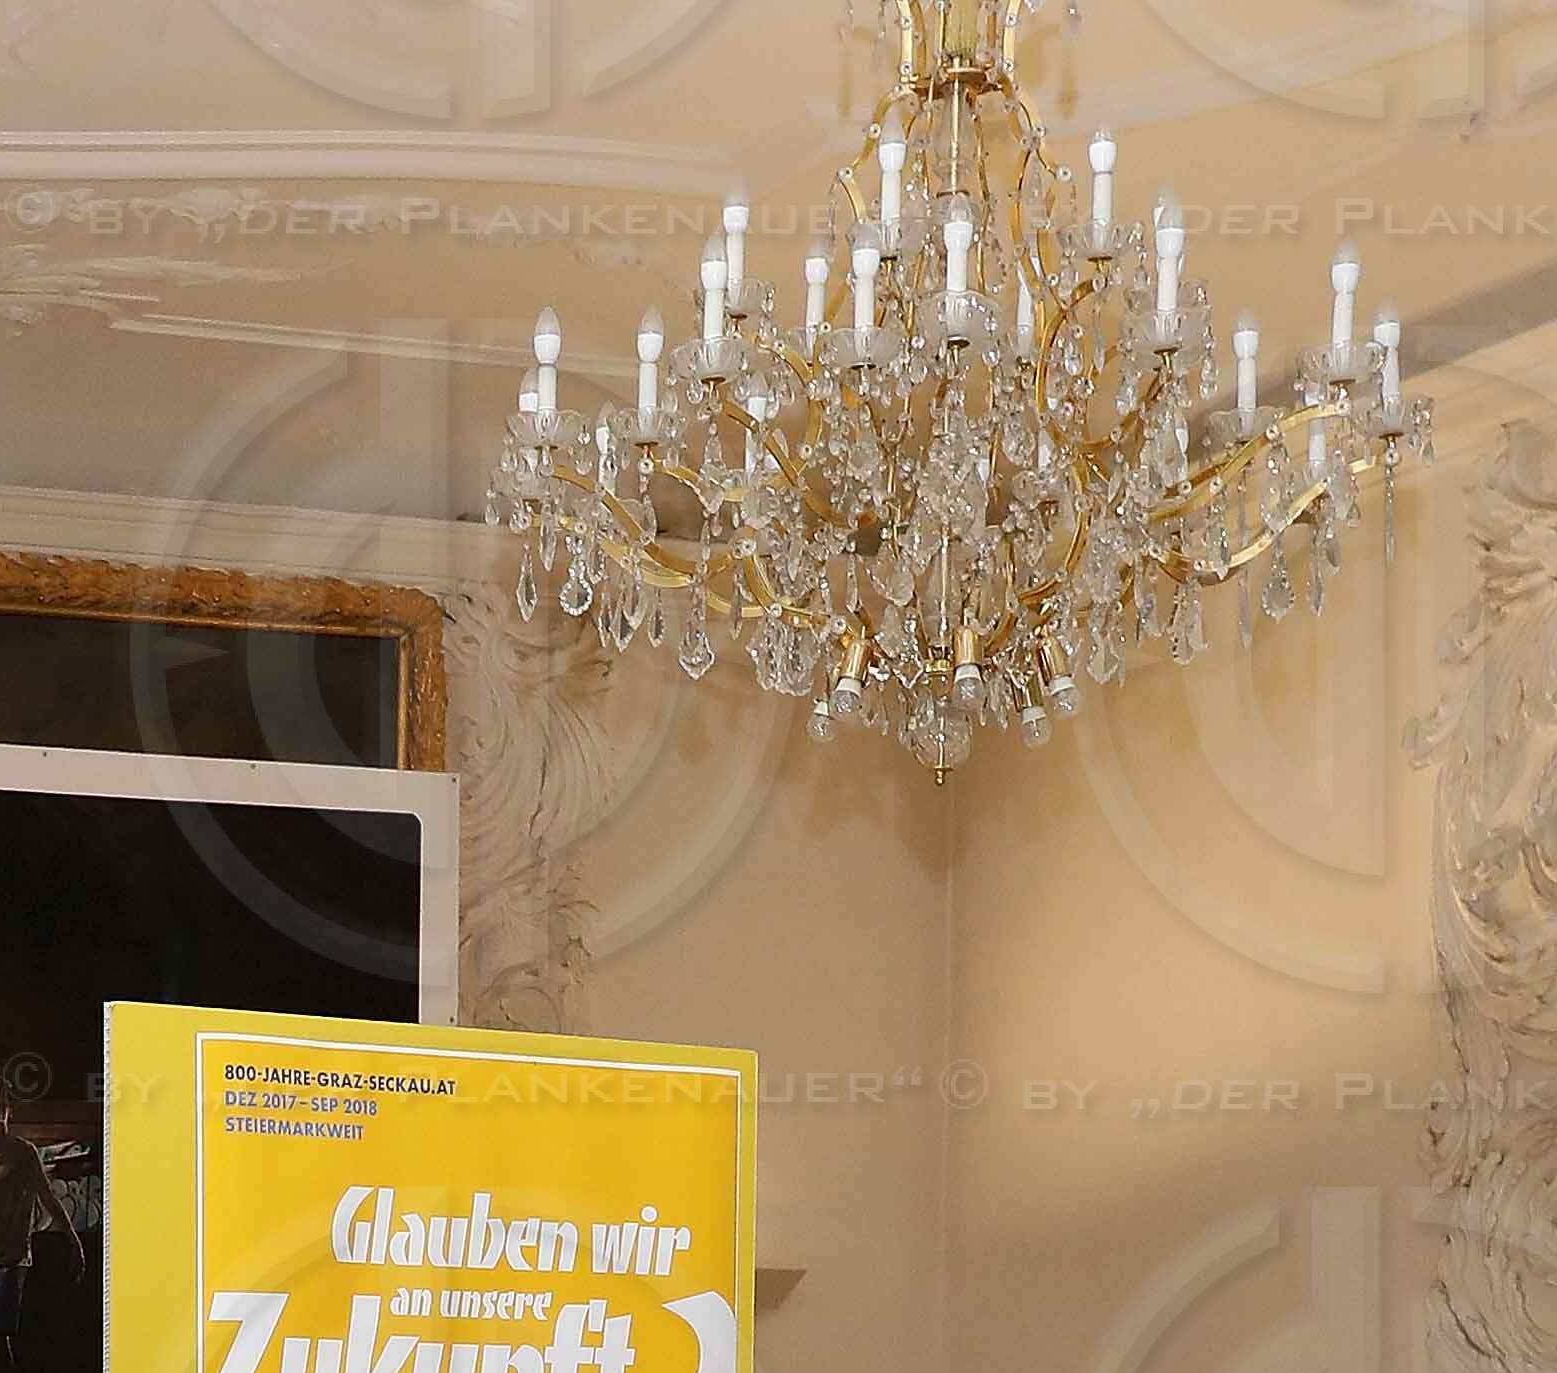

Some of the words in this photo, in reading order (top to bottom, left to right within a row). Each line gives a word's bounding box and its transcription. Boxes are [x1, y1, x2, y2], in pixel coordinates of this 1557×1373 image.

[225, 1065, 456, 1095] 800-JAHRE-GRAZ-SECKAU.AT
[225, 1090, 257, 1107] DEZ
[262, 1093, 297, 1110] 2017
[311, 1097, 338, 1113] SEP
[344, 1098, 377, 1116] 2018
[225, 1117, 364, 1140] STEIERMARKWEIT
[331, 1185, 580, 1273] Glauben
[590, 1205, 692, 1277] wir
[390, 1286, 432, 1317] an
[439, 1286, 553, 1322] unsere
